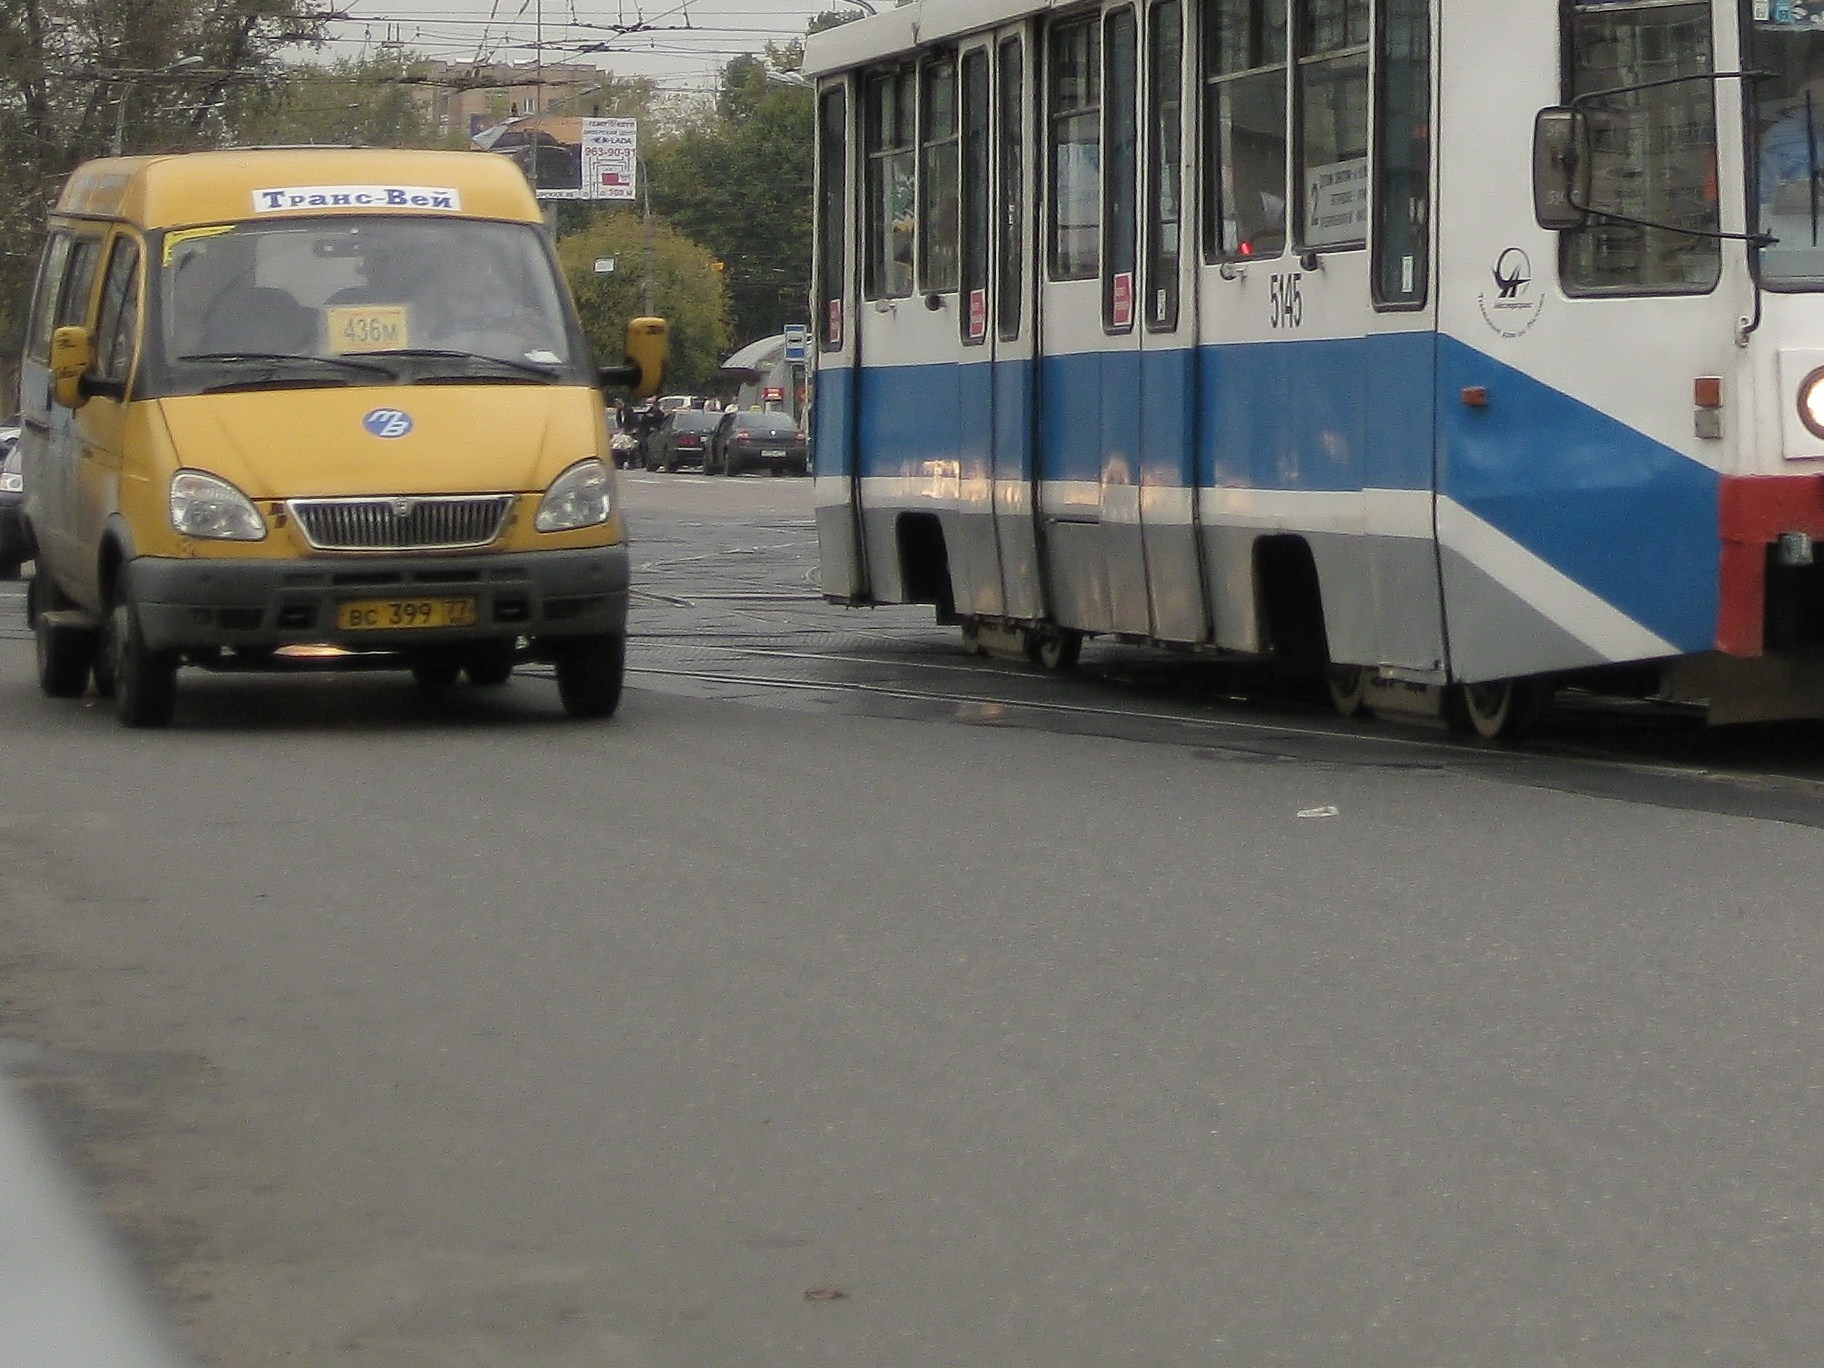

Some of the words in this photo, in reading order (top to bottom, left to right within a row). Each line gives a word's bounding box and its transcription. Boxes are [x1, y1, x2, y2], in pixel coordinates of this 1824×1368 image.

[262, 188, 454, 209] Транс-Вей
[1270, 273, 1302, 329] 5145
[389, 602, 432, 625] 399
